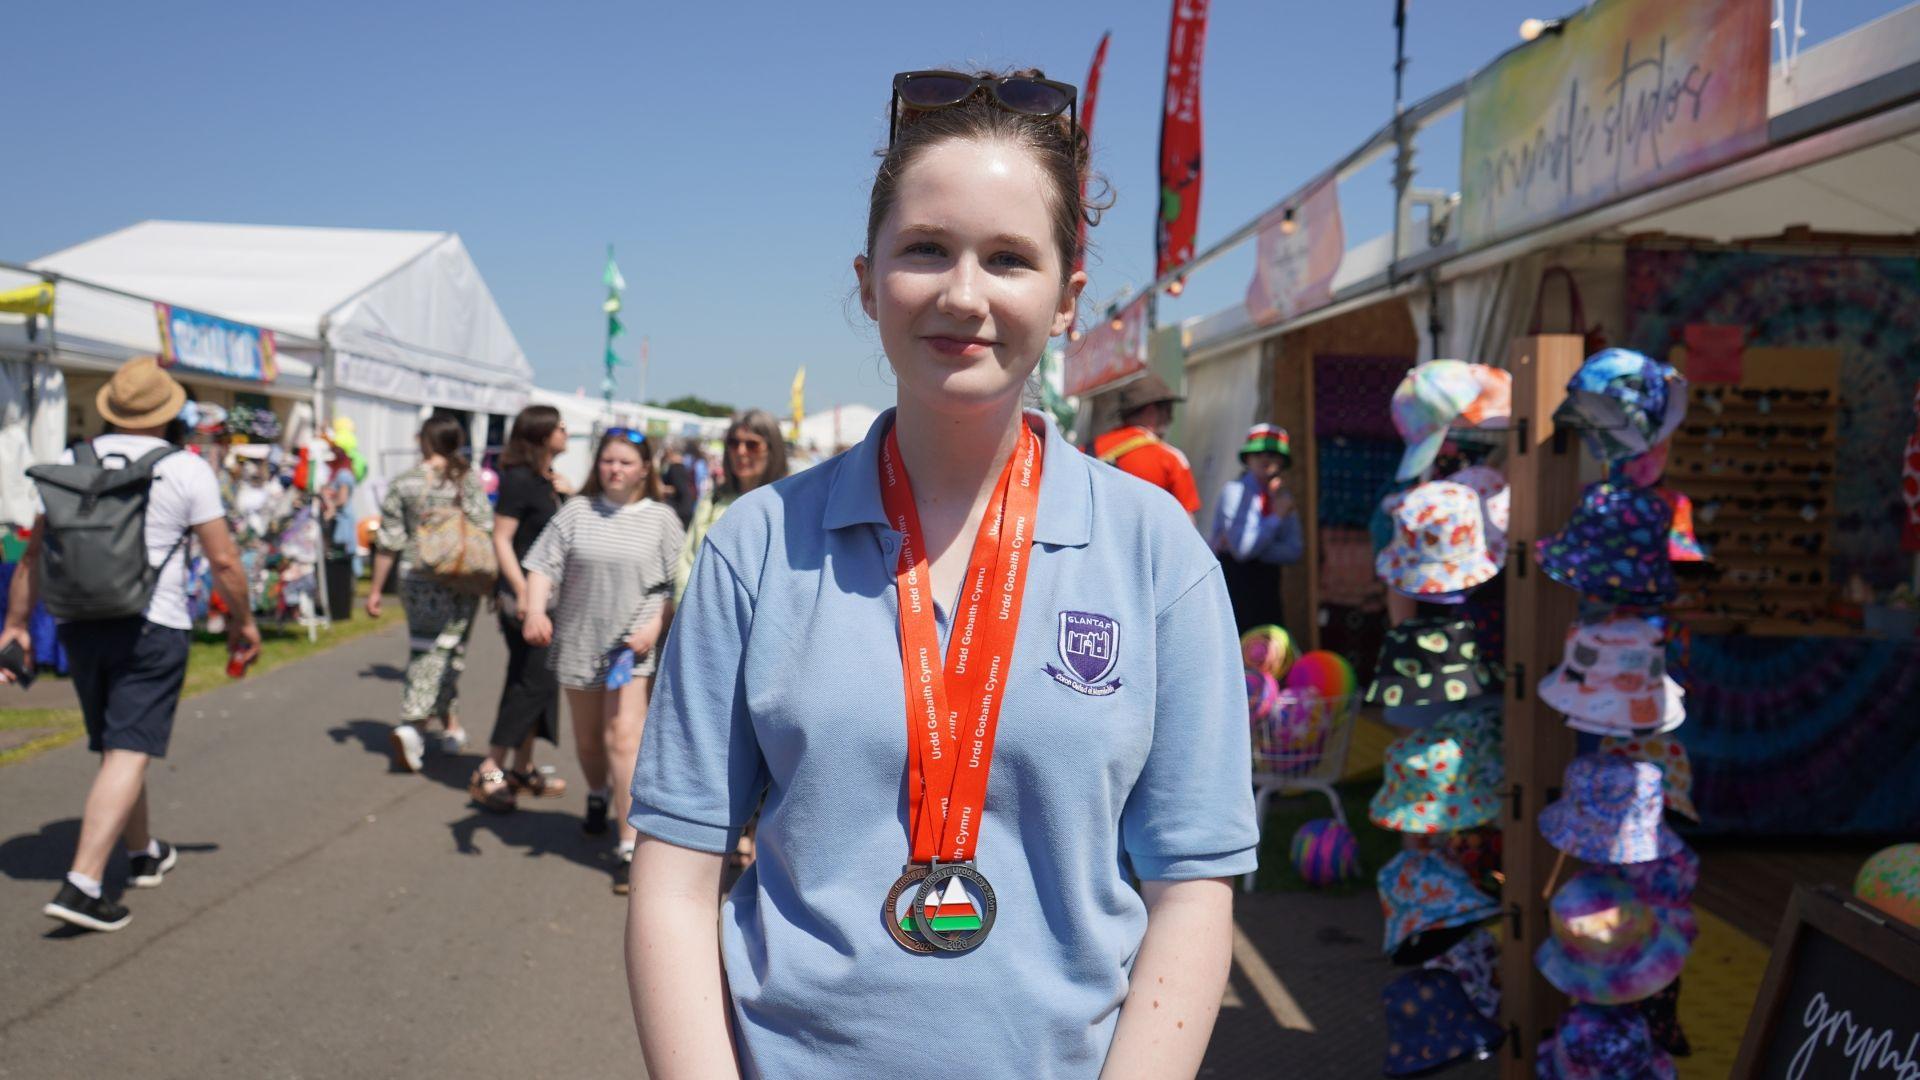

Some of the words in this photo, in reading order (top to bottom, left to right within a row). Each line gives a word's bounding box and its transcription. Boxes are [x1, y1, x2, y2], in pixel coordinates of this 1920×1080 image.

[1011, 516, 1025, 548] Cymru
[904, 548, 918, 585] Gobaith
[1004, 550, 1020, 592] Gobaith
[909, 586, 921, 613] Urdd
[971, 567, 986, 601] Cymru
[999, 594, 1012, 620] Urdd
[1067, 616, 1112, 629] GLANTAF
[962, 604, 978, 645] Gobaith
[919, 647, 931, 683] Cymru
[956, 648, 970, 675] Urdd
[985, 655, 1000, 691] Cymru
[921, 684, 937, 729] Gobaith
[975, 694, 993, 738] Gobaith
[927, 732, 942, 760] Urdd
[969, 740, 984, 768] Urdd
[956, 806, 971, 845] Cymru
[952, 867, 973, 876] Urdd
